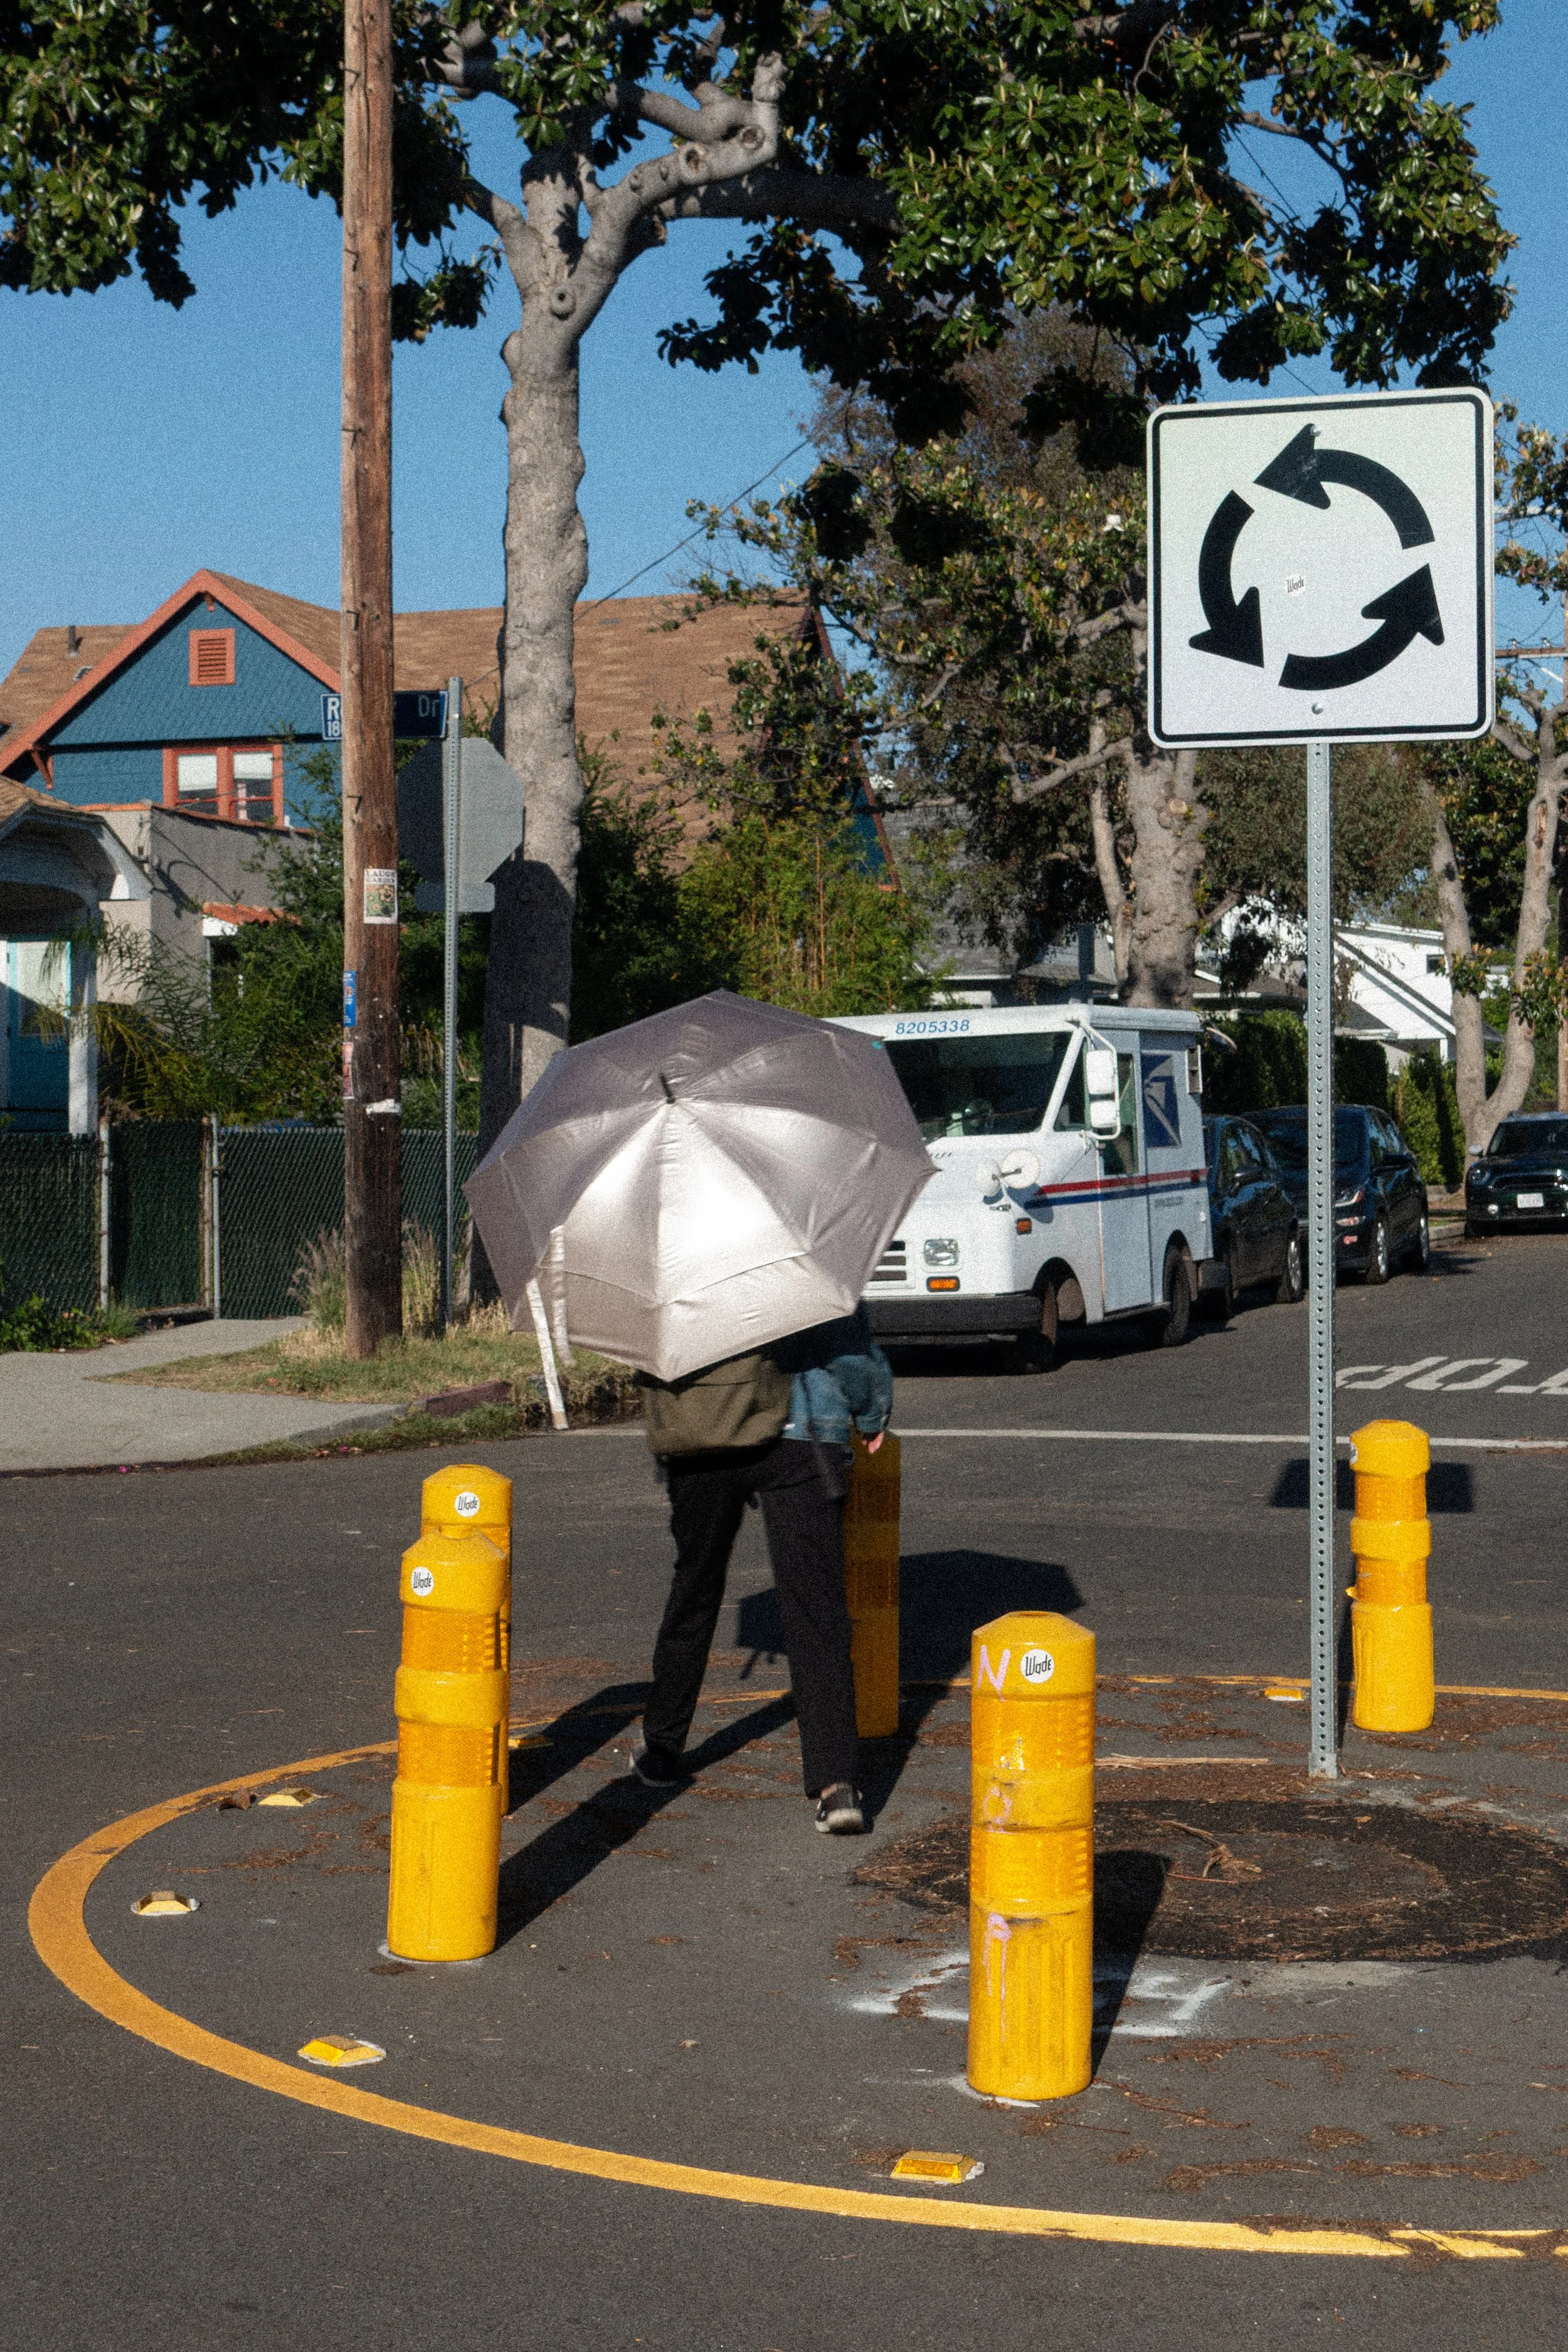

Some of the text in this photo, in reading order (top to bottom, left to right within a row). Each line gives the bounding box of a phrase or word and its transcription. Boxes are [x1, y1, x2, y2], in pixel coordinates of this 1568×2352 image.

[1286, 576, 1304, 593] Wade
[418, 694, 440, 718] Dr
[896, 1019, 970, 1034] 8205338
[1335, 1356, 1568, 1394] TOP
[457, 1496, 478, 1511] Wade
[413, 1571, 432, 1589] Wade
[1025, 1655, 1052, 1677] Wade
